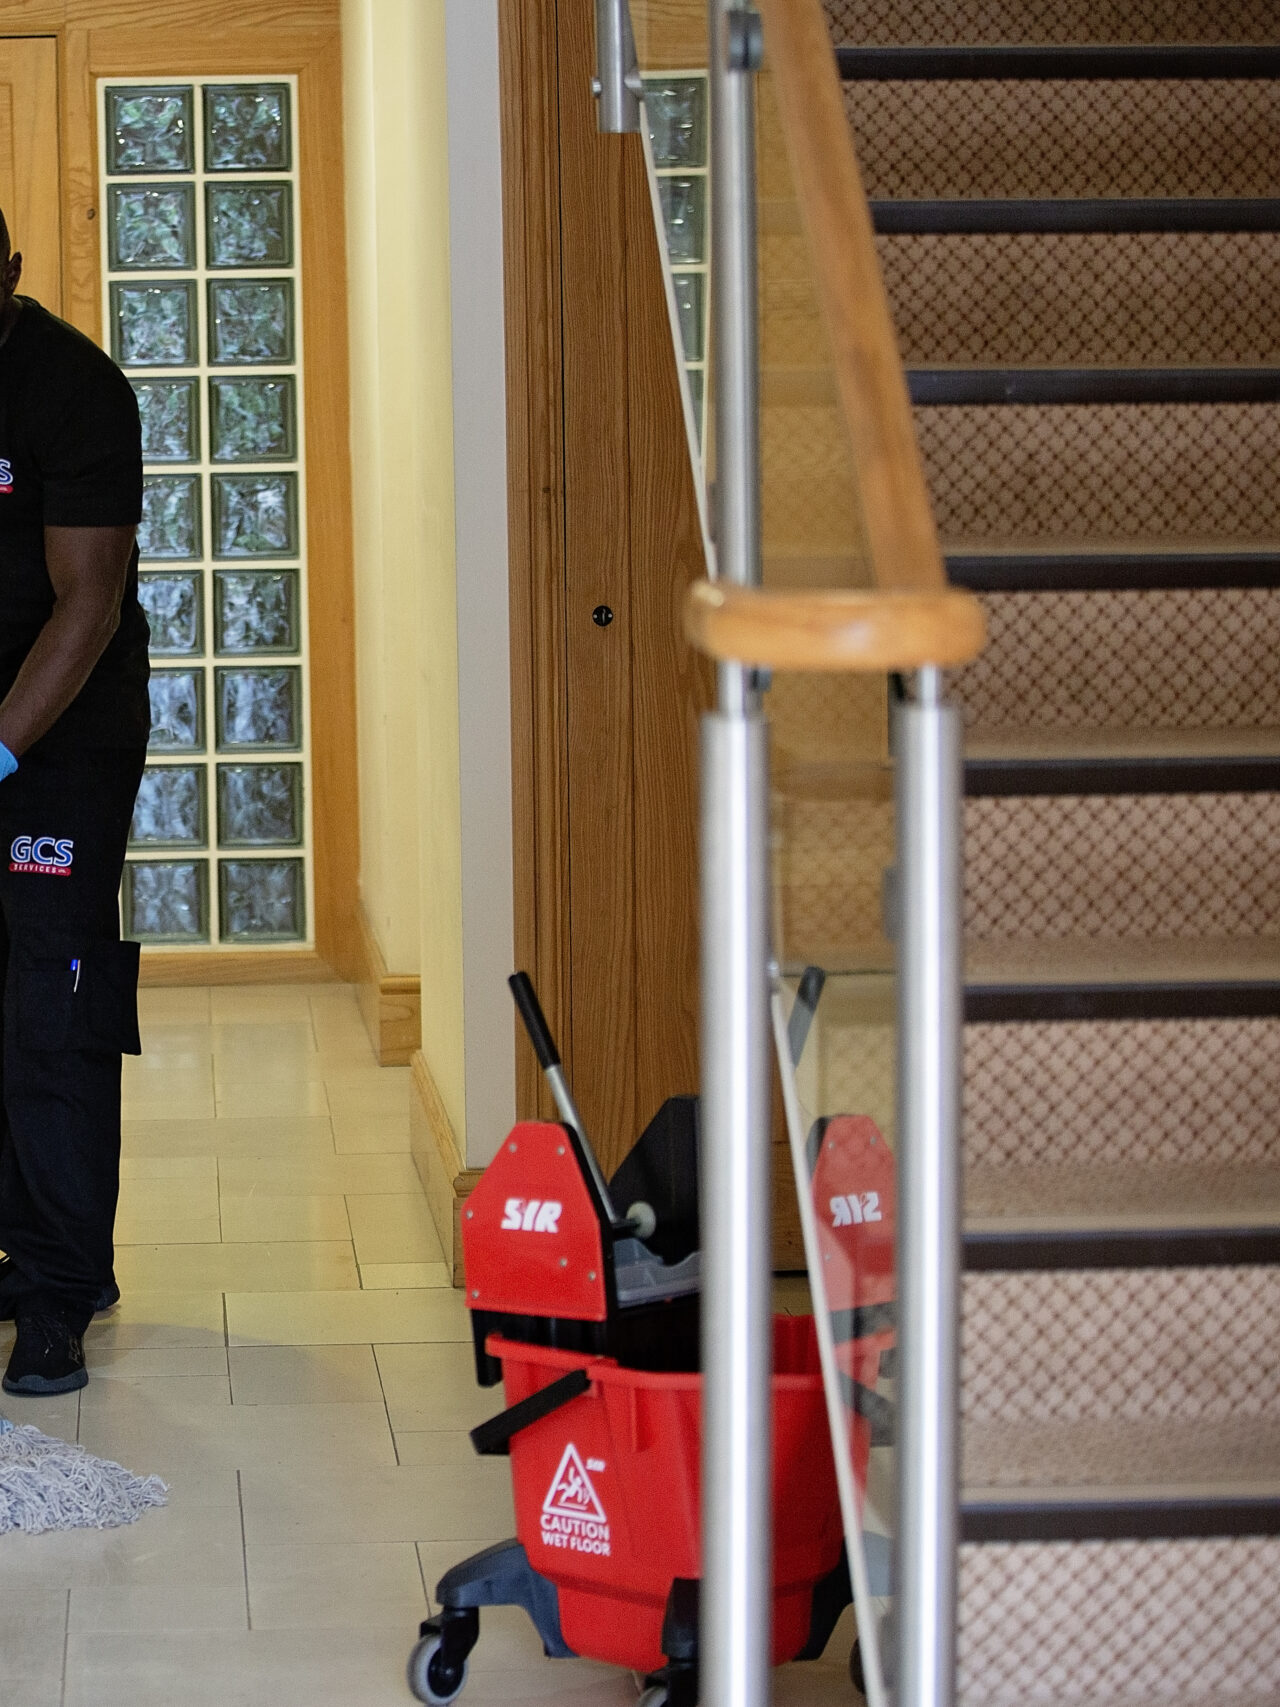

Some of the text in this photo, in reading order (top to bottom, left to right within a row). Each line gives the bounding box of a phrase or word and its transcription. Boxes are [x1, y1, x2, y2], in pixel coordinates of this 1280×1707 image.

[10, 835, 74, 867] GCS
[13, 863, 57, 874] SERVICES
[501, 1198, 562, 1233] SIR
[540, 1514, 610, 1541] CAUTION
[541, 1531, 612, 1557] WET FLOOR
